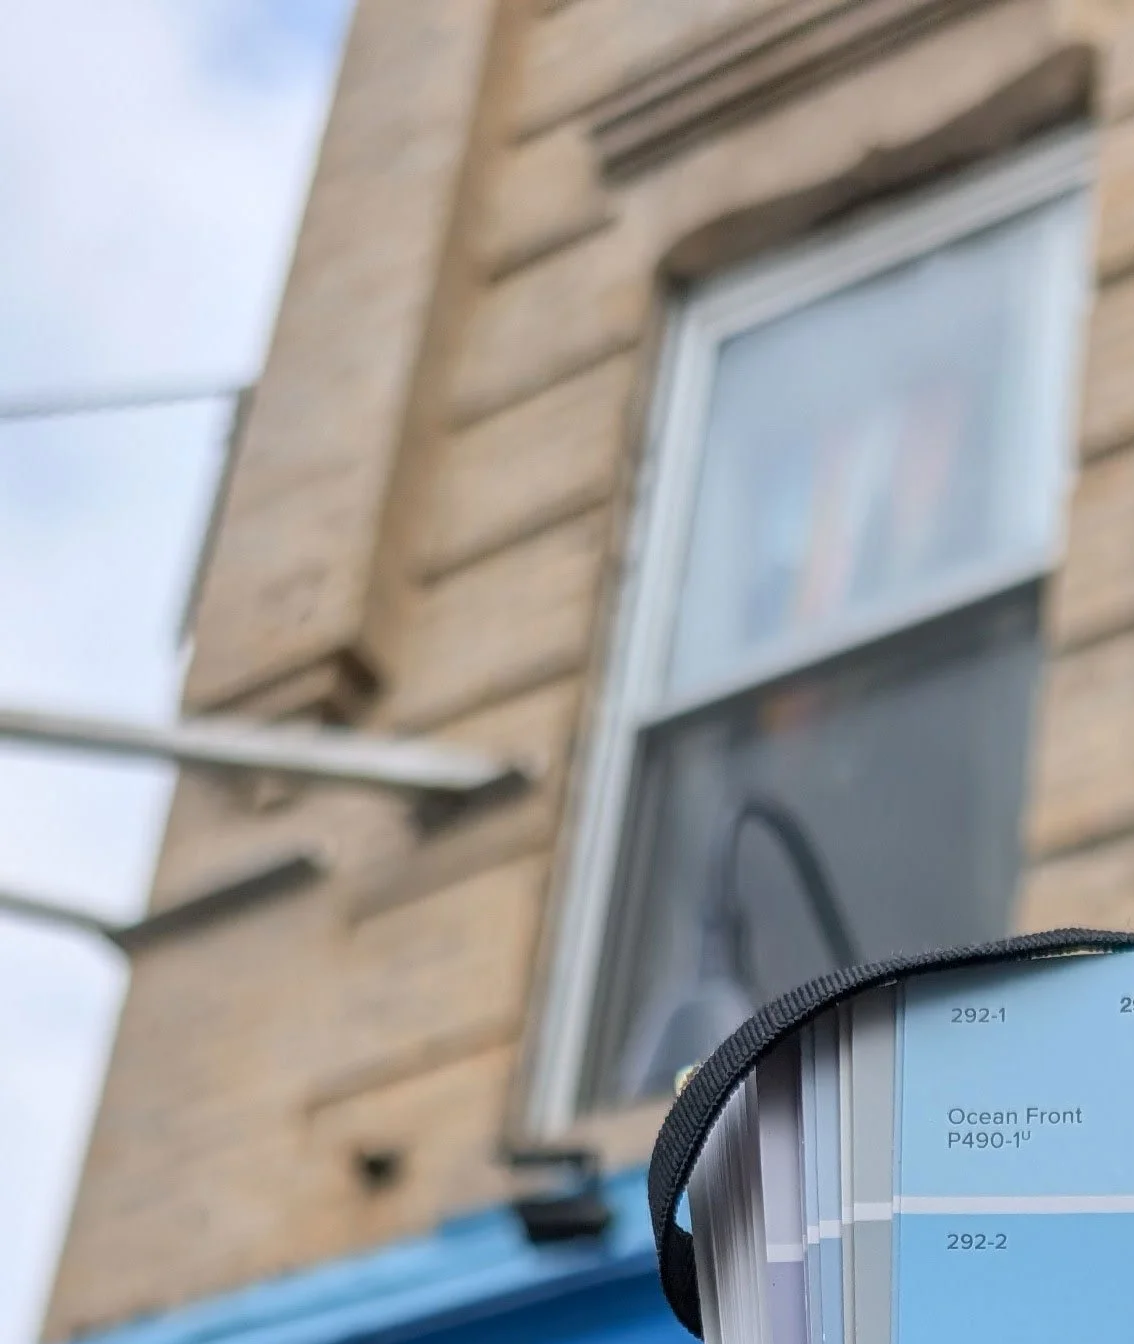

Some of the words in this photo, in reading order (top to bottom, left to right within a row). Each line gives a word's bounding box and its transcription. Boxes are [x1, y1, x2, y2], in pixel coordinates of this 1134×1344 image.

[949, 1006, 1008, 1025] 292-1
[946, 1107, 1018, 1127] Ocean
[1026, 1107, 1083, 1125] Front
[947, 1233, 1008, 1251] 292-2
